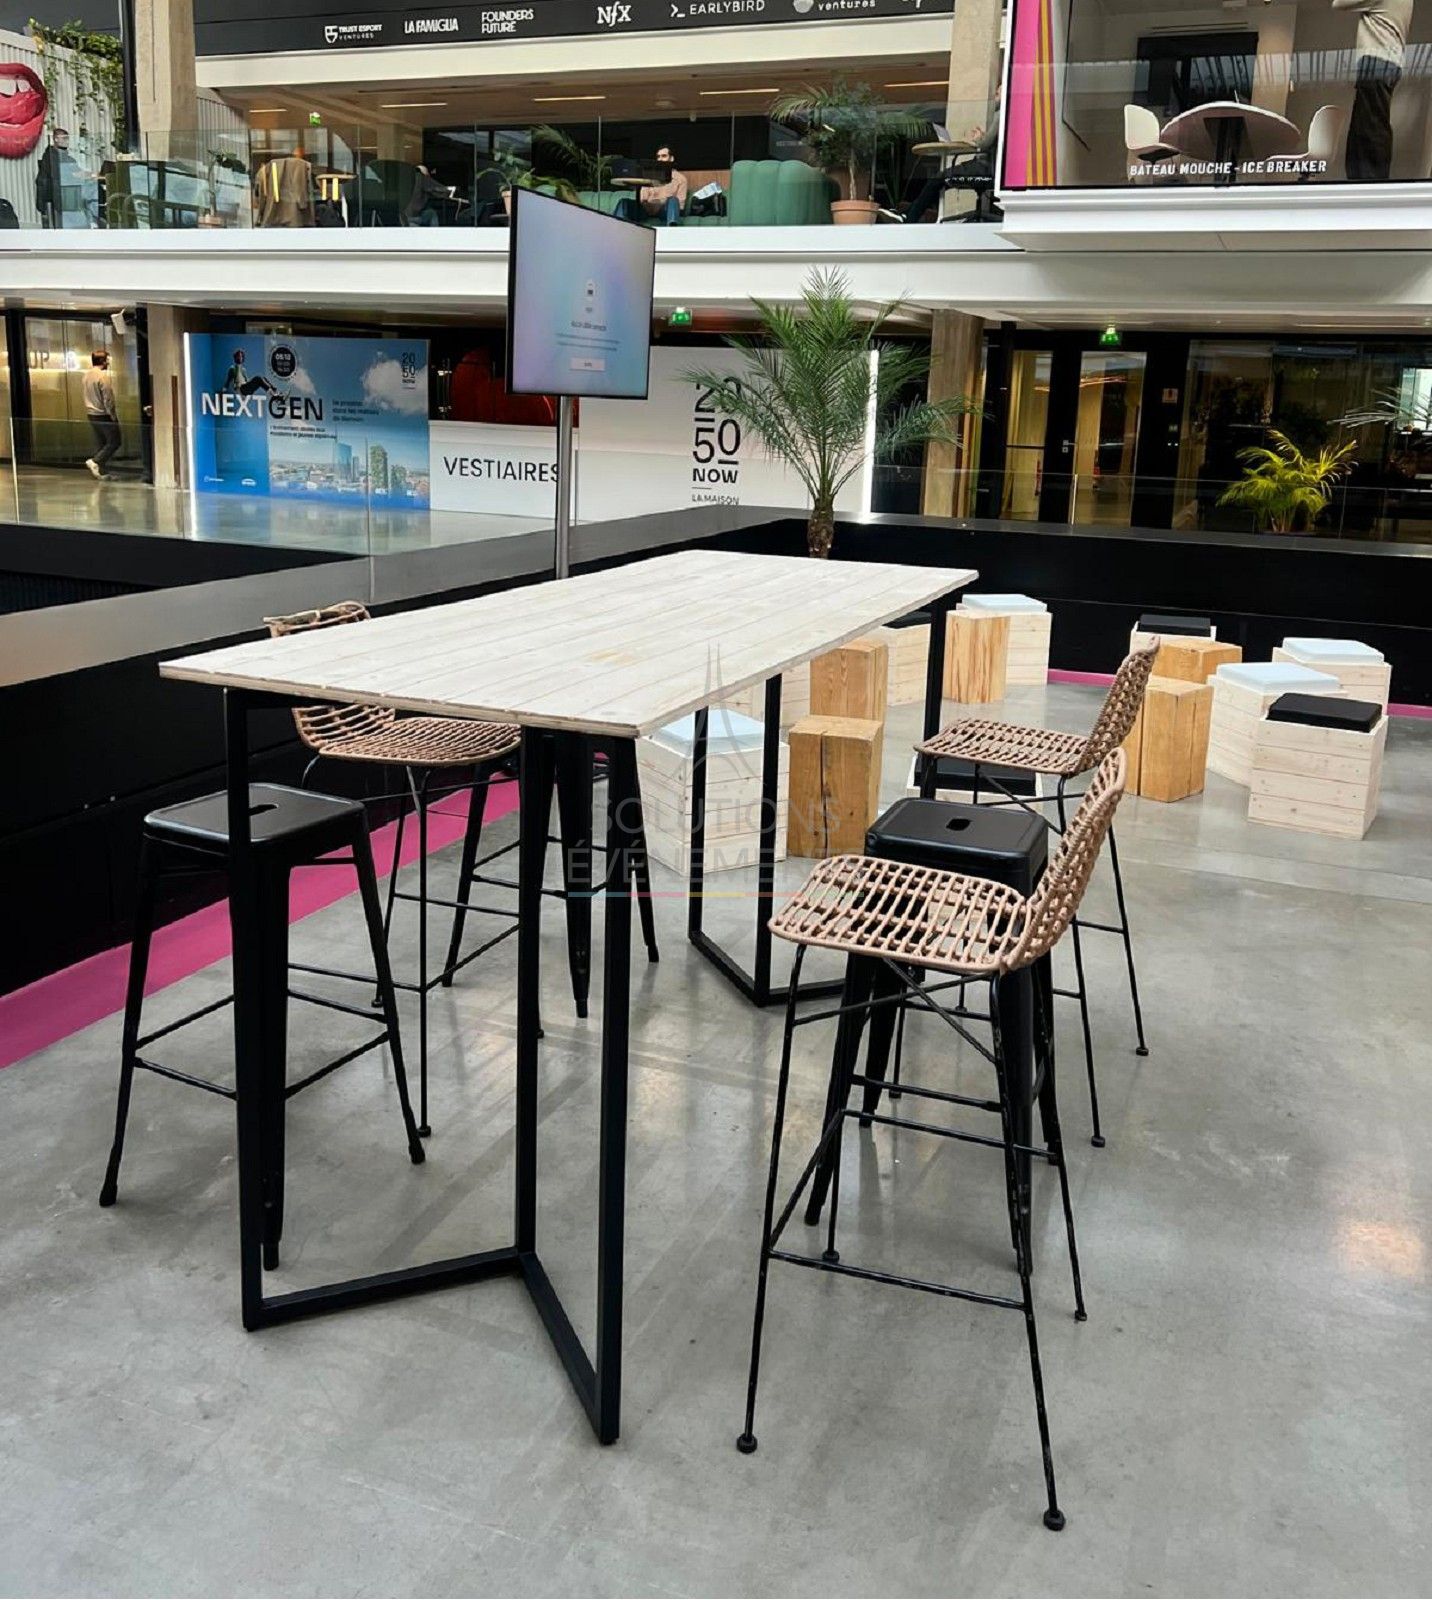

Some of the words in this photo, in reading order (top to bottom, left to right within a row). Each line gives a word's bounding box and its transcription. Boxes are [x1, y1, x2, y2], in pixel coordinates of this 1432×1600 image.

[689, 0, 766, 15] EARLYBIRD
[818, 0, 876, 11] ventures
[481, 9, 534, 22] FOUNDERS
[358, 24, 382, 32] ESPORT
[404, 20, 415, 34] LA
[416, 18, 459, 33] FAMIGLIA
[481, 21, 517, 34] FUTURE
[1130, 163, 1176, 176] BATEAU
[1179, 162, 1231, 175] MOUCHE
[1242, 161, 1264, 173] ICE
[1266, 160, 1327, 173] BREAKER
[201, 392, 323, 421] NEXTGEN
[692, 418, 741, 464] 50
[443, 456, 558, 483] VESTIAIRES
[692, 468, 738, 483] NOW
